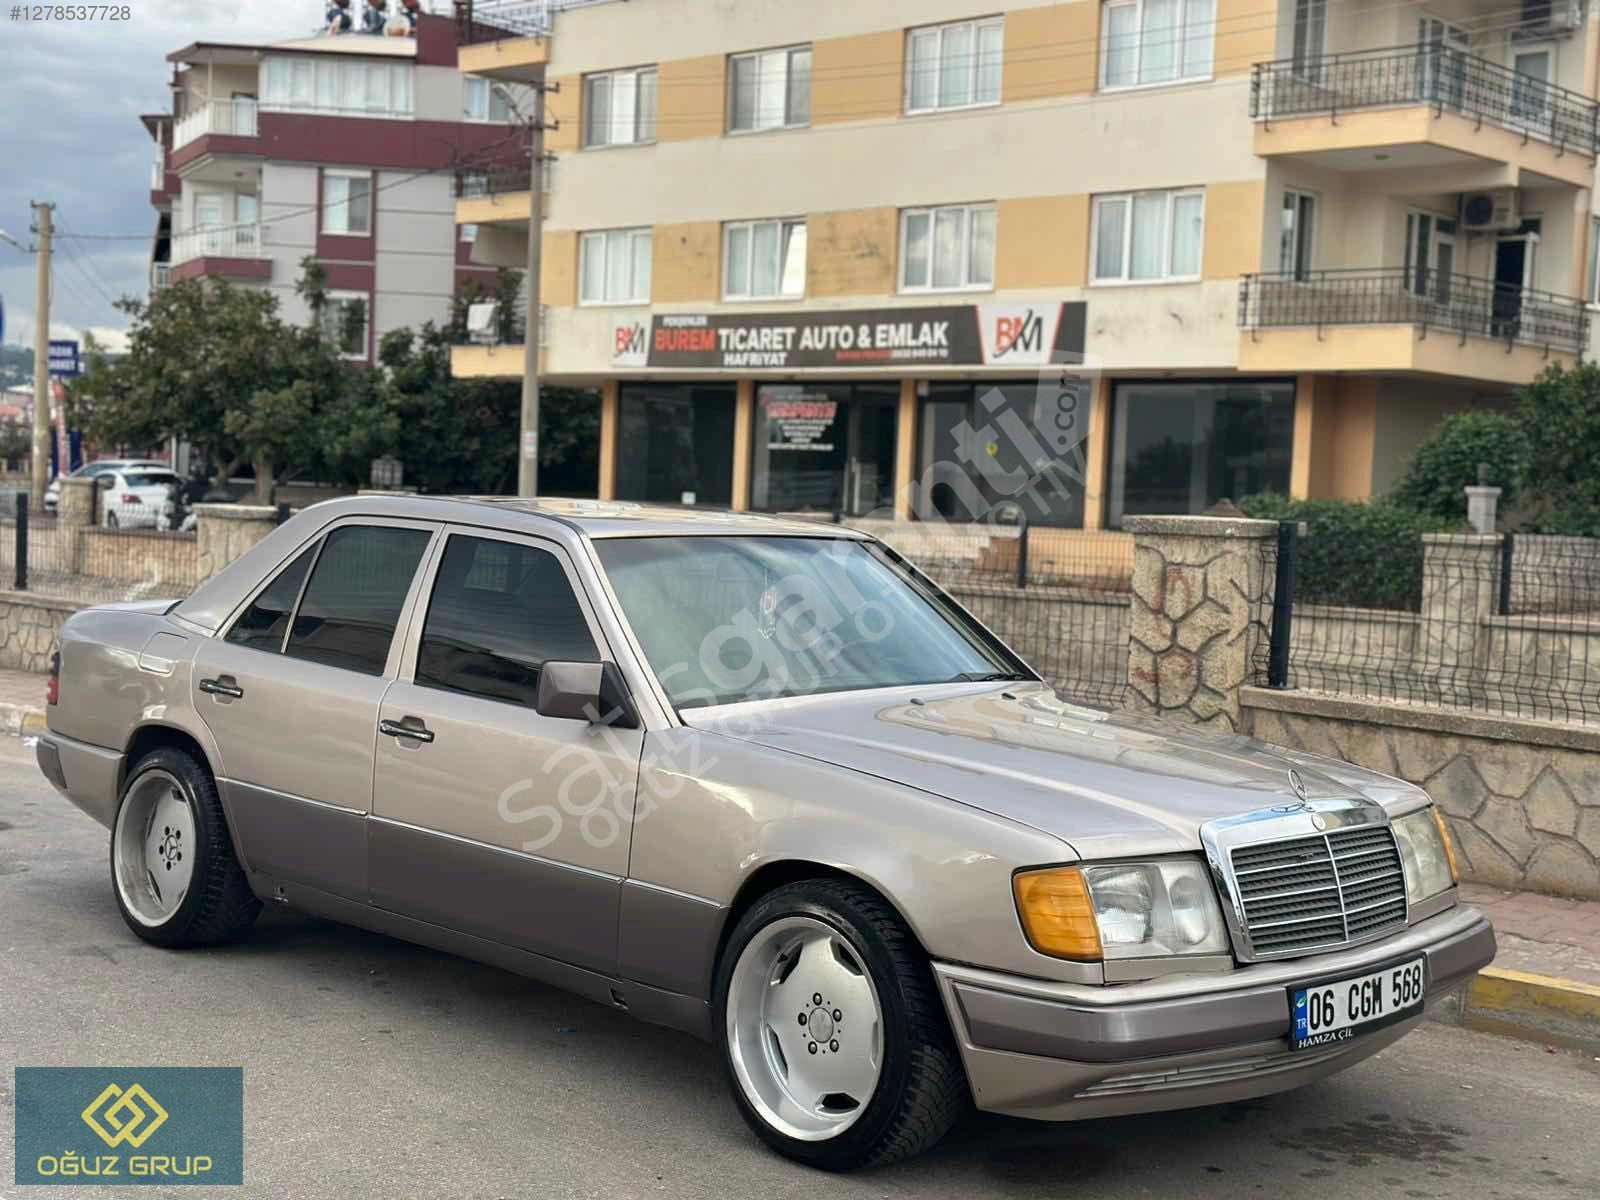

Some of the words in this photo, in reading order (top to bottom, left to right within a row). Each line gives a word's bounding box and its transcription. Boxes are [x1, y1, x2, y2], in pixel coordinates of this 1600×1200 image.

[655, 328, 716, 351] BUREM
[799, 325, 854, 349] AUTO
[857, 324, 872, 348] &
[875, 321, 950, 347] EMLAK
[1309, 989, 1335, 1031] 06
[1348, 976, 1383, 1020] CGM
[1392, 964, 1422, 1008] 568
[1296, 1018, 1307, 1030] TR
[1298, 1033, 1336, 1048] HAMZA
